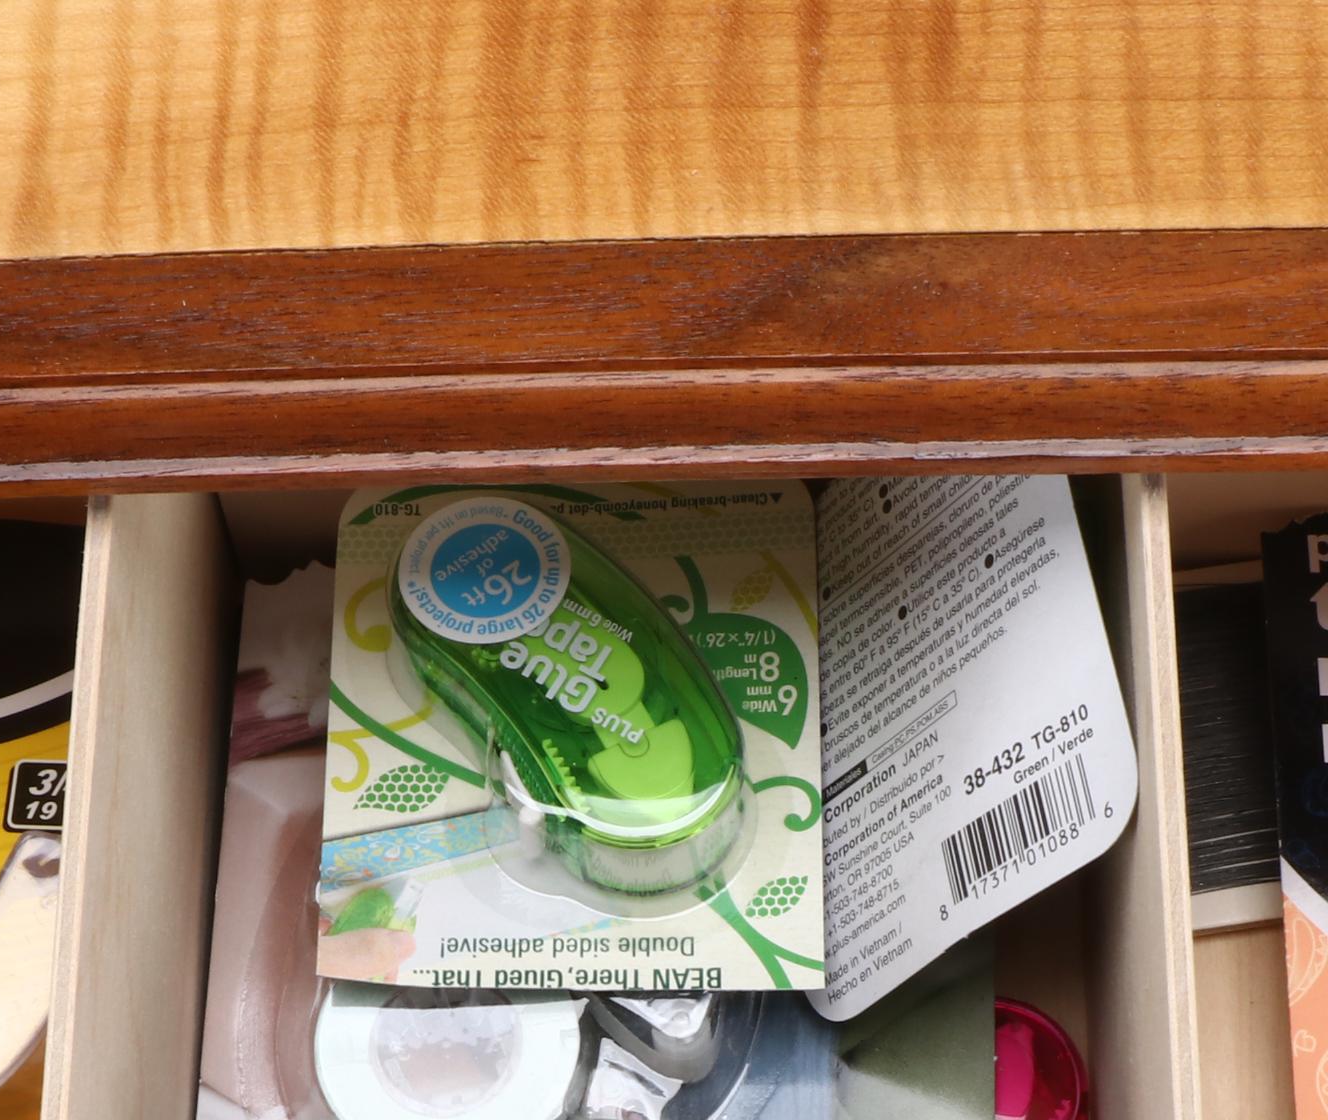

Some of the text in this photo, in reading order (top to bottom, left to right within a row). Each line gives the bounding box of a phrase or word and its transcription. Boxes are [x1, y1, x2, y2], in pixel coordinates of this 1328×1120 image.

[433, 527, 510, 583] adhesive
[475, 557, 493, 576] of
[498, 639, 598, 713] Glue
[833, 628, 1007, 765] alejado del alcance de niños pequeños.
[590, 705, 645, 745] PLUS
[963, 704, 1089, 795] 38-432 TG-810
[29, 769, 68, 796] 3/
[824, 729, 939, 823] Corporation JAPAN
[1013, 726, 1094, 784] Green / Verde
[26, 801, 58, 820] 19
[824, 817, 886, 866] Corporation
[887, 804, 899, 821] of
[901, 774, 943, 811] America
[846, 832, 915, 887] OR 97005 USA
[939, 801, 1114, 921] 8 17371 01088 6
[438, 935, 695, 958] Double sided adhesive!
[827, 937, 913, 1005] Hecho en Vietnam
[492, 967, 563, 989] Glued
[566, 963, 643, 989] There,
[651, 965, 722, 989] BEAN
